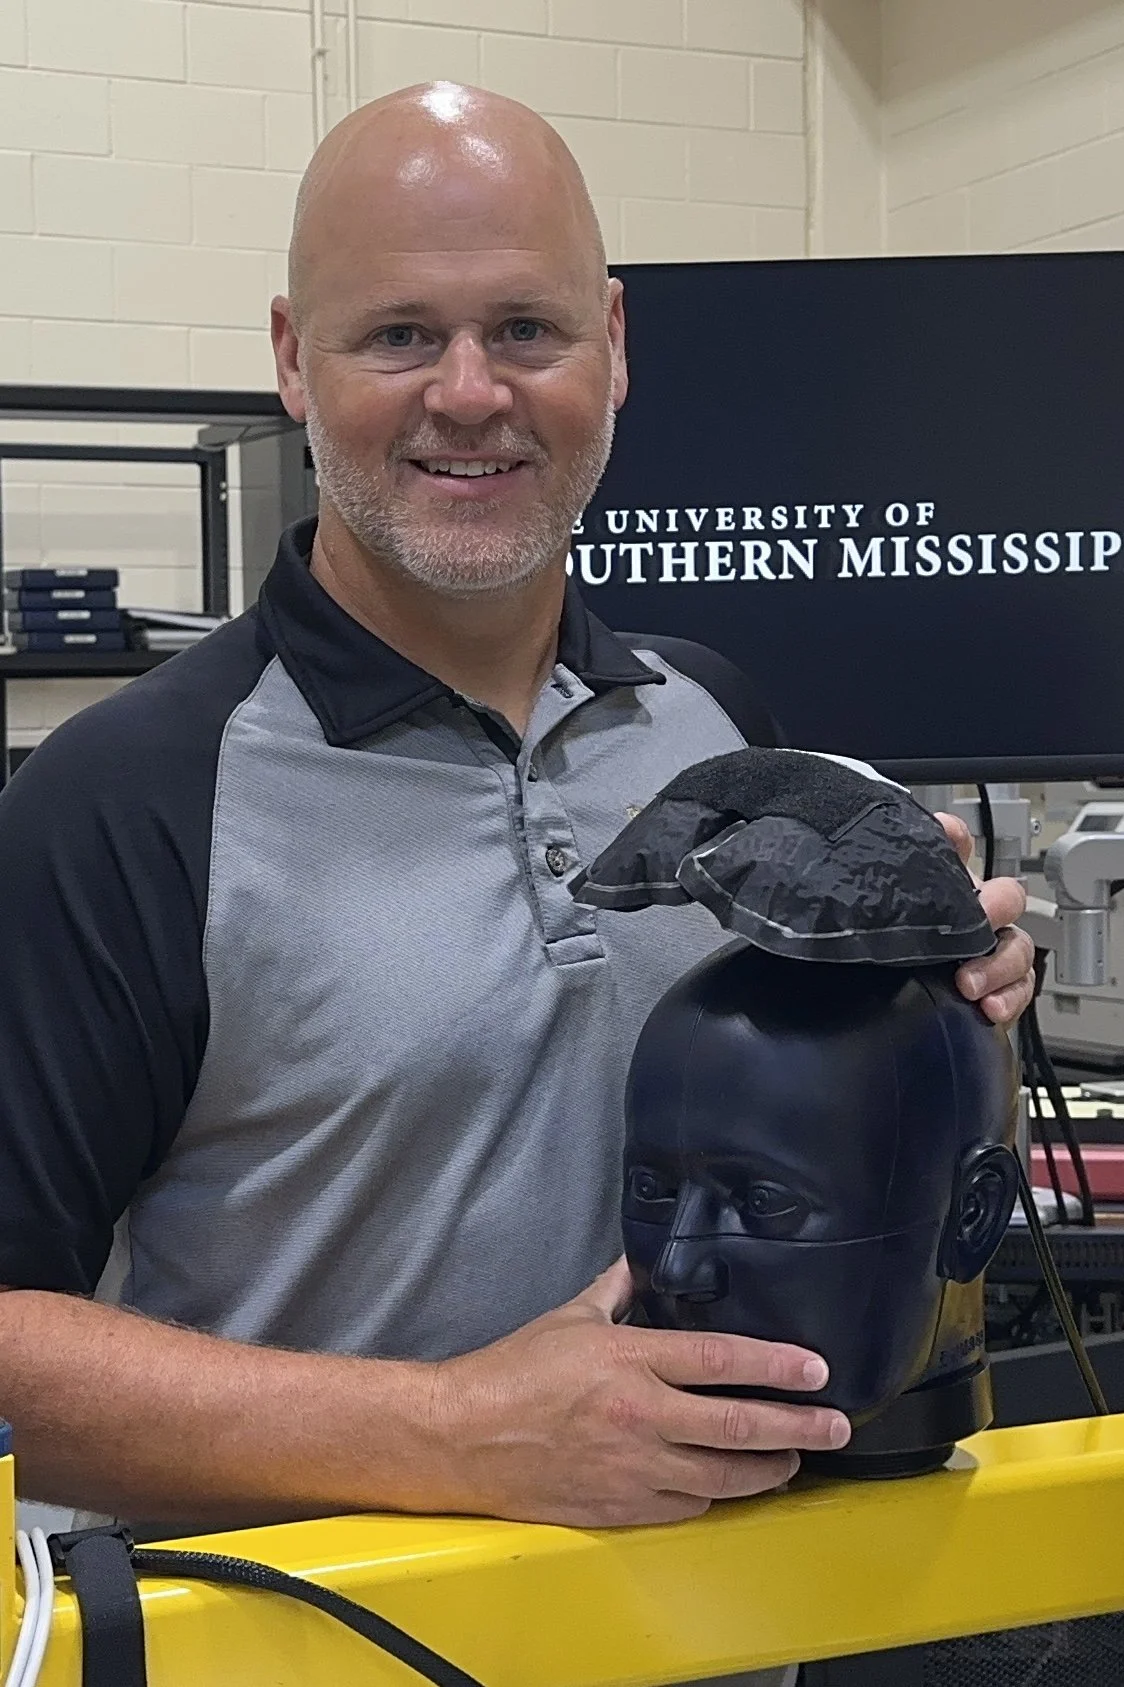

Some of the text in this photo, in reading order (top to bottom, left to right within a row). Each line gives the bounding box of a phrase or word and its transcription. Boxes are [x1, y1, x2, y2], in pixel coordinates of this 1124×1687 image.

[606, 504, 863, 534] UNIVERSITY
[885, 503, 935, 527] OF
[565, 538, 818, 585] UTHERN
